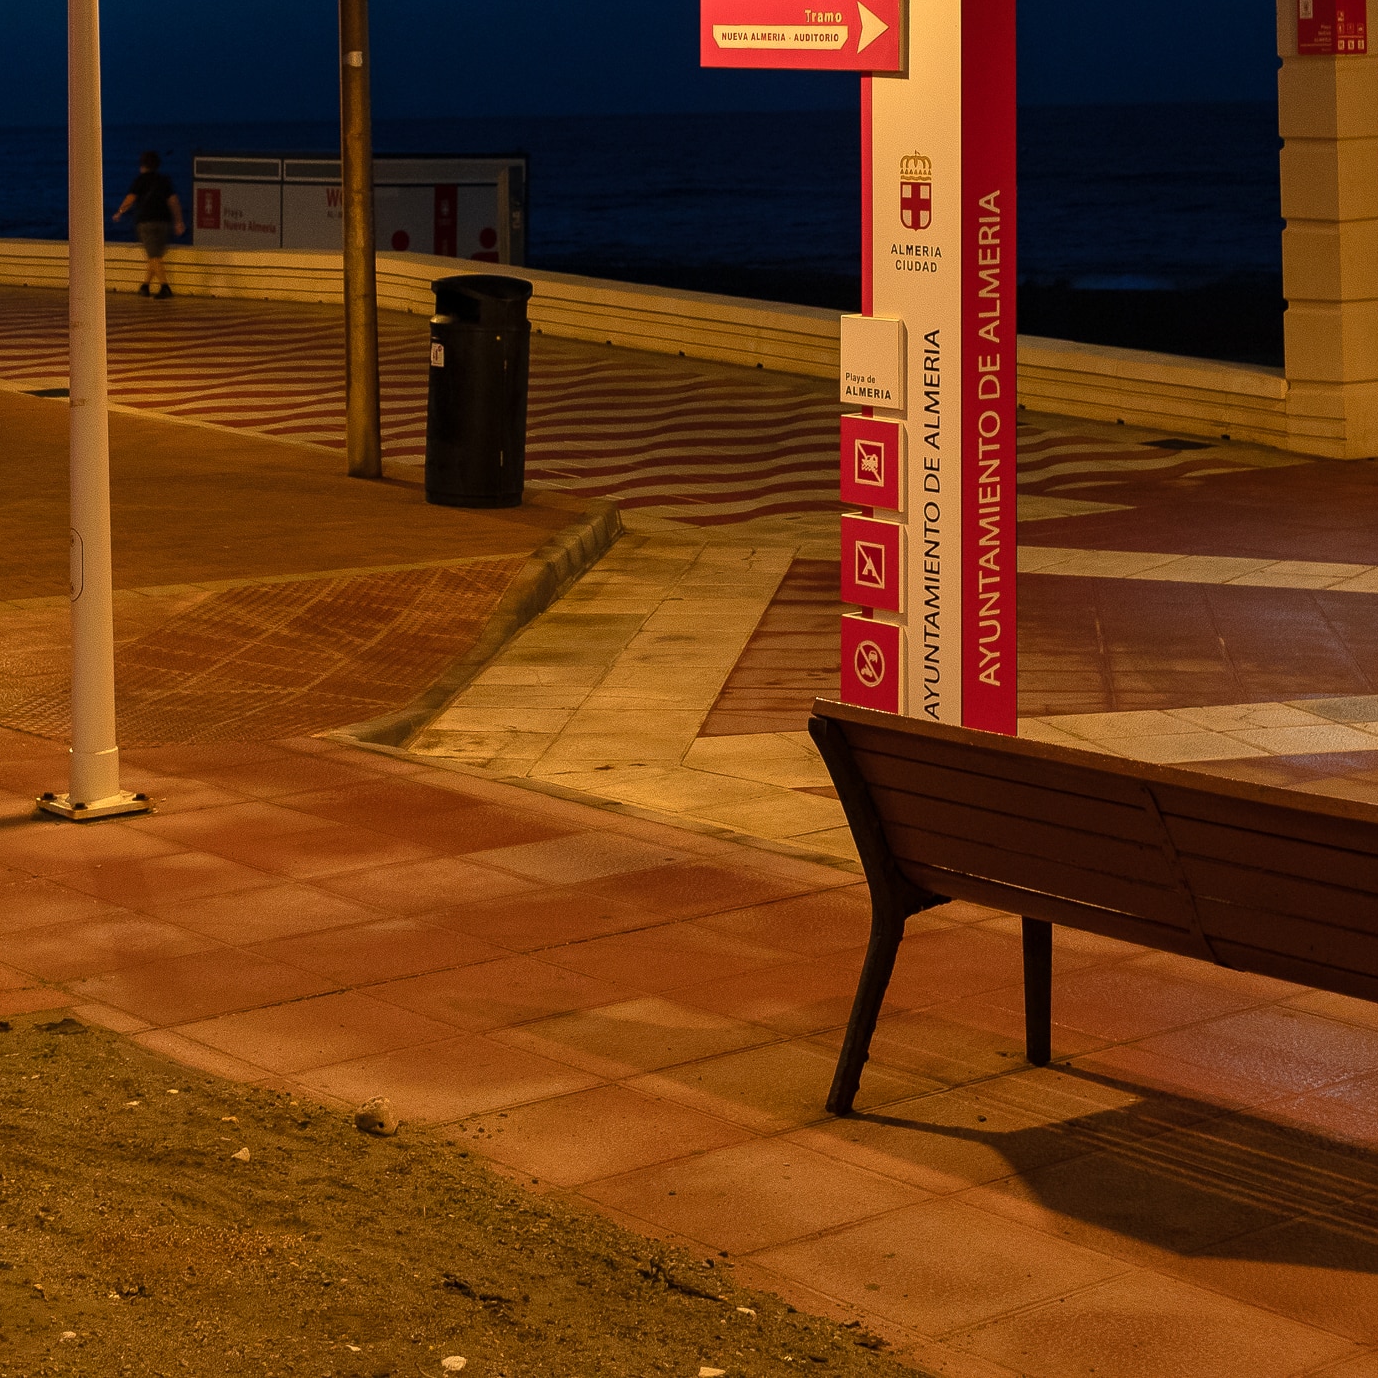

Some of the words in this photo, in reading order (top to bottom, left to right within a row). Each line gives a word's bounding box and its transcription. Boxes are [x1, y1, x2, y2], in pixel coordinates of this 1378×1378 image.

[805, 9, 842, 22] Tramo
[722, 32, 749, 41] NUEVA
[751, 32, 786, 41] ALMERIA
[794, 33, 839, 42] AUDITORIO
[891, 243, 942, 258] ALMERIA
[895, 259, 937, 272] CIUDAD
[978, 189, 1001, 343] ALMERIA
[845, 372, 865, 384] Playa
[867, 375, 876, 384] de
[924, 329, 941, 450] ALMERIA
[978, 353, 1001, 400] DE
[845, 385, 892, 400] ALMERIA
[924, 457, 941, 494] DE
[978, 410, 1001, 687] AYUNTAMIENTO
[924, 501, 941, 721] AYUNTAMIENTO
